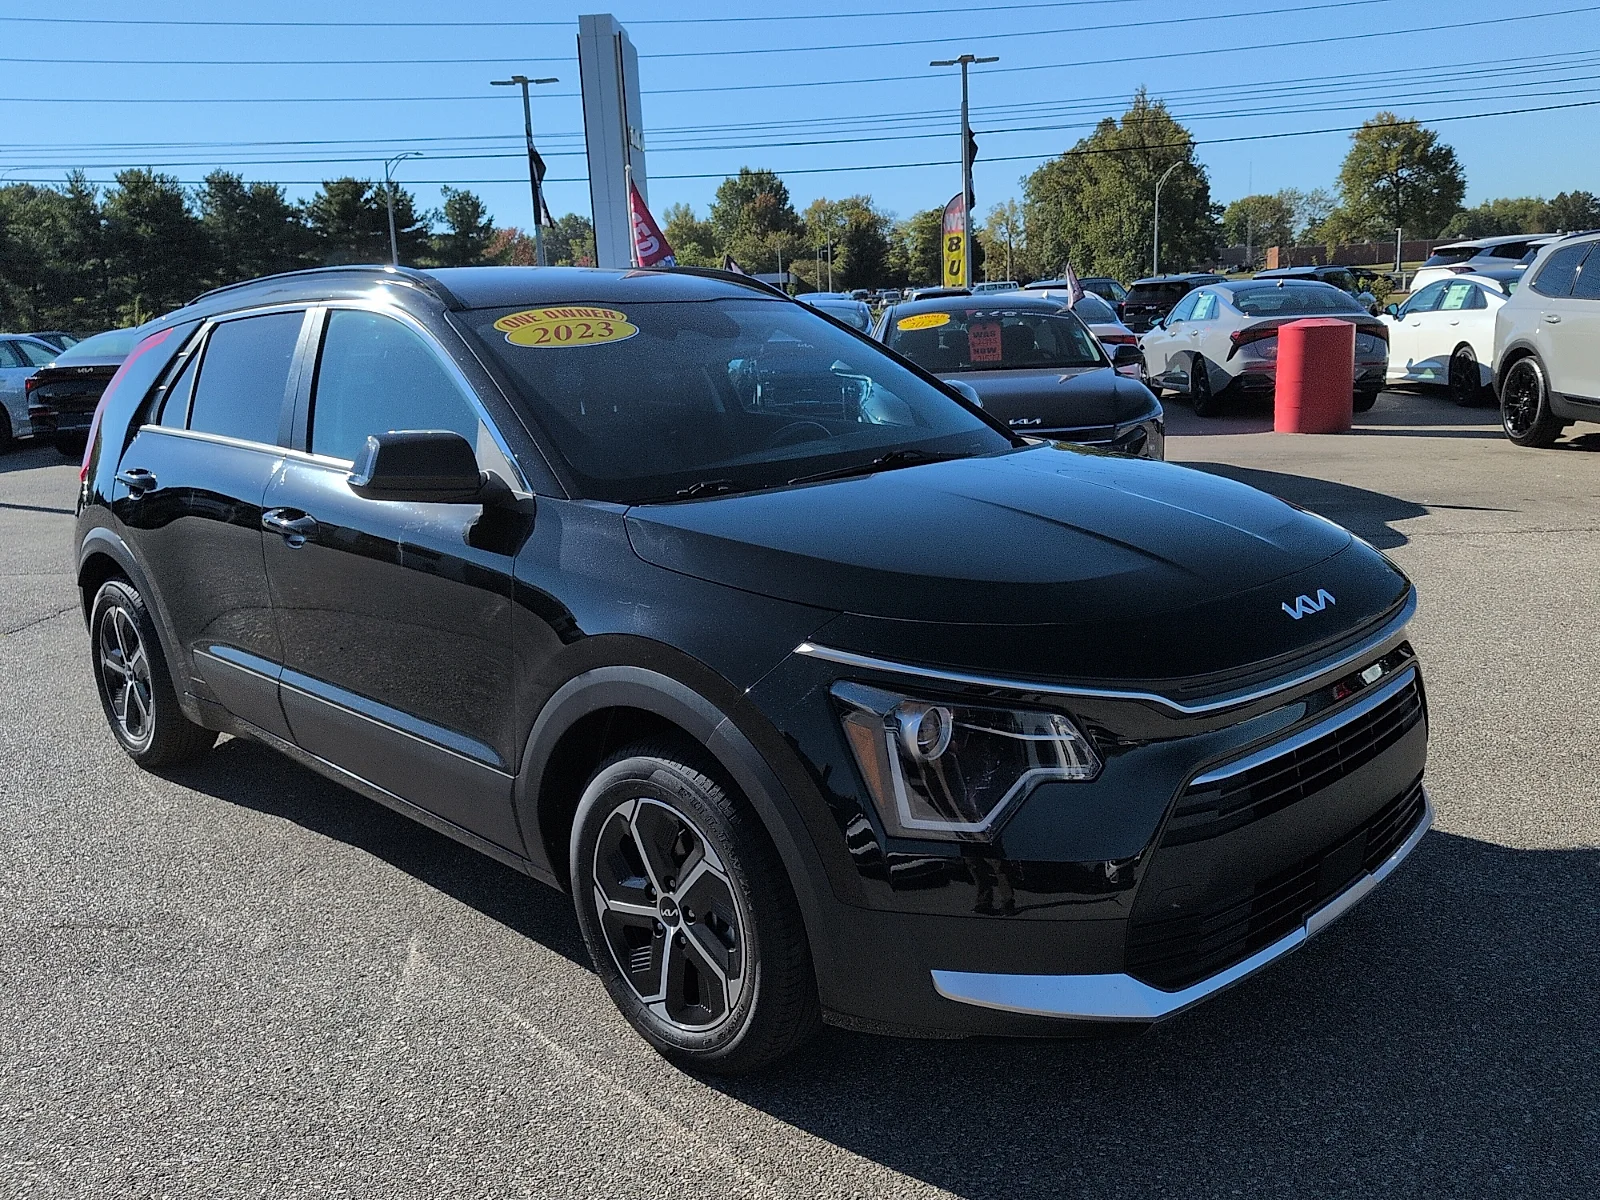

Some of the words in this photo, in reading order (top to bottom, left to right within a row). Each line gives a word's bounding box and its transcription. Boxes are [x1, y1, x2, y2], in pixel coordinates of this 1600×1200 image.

[502, 312, 542, 329] ONE
[542, 308, 616, 320] OWNER
[532, 321, 615, 344] 2023
[972, 330, 996, 338] WAS
[972, 346, 997, 354] NOW
[1281, 588, 1336, 620] KIA
[660, 908, 678, 917] KIA
